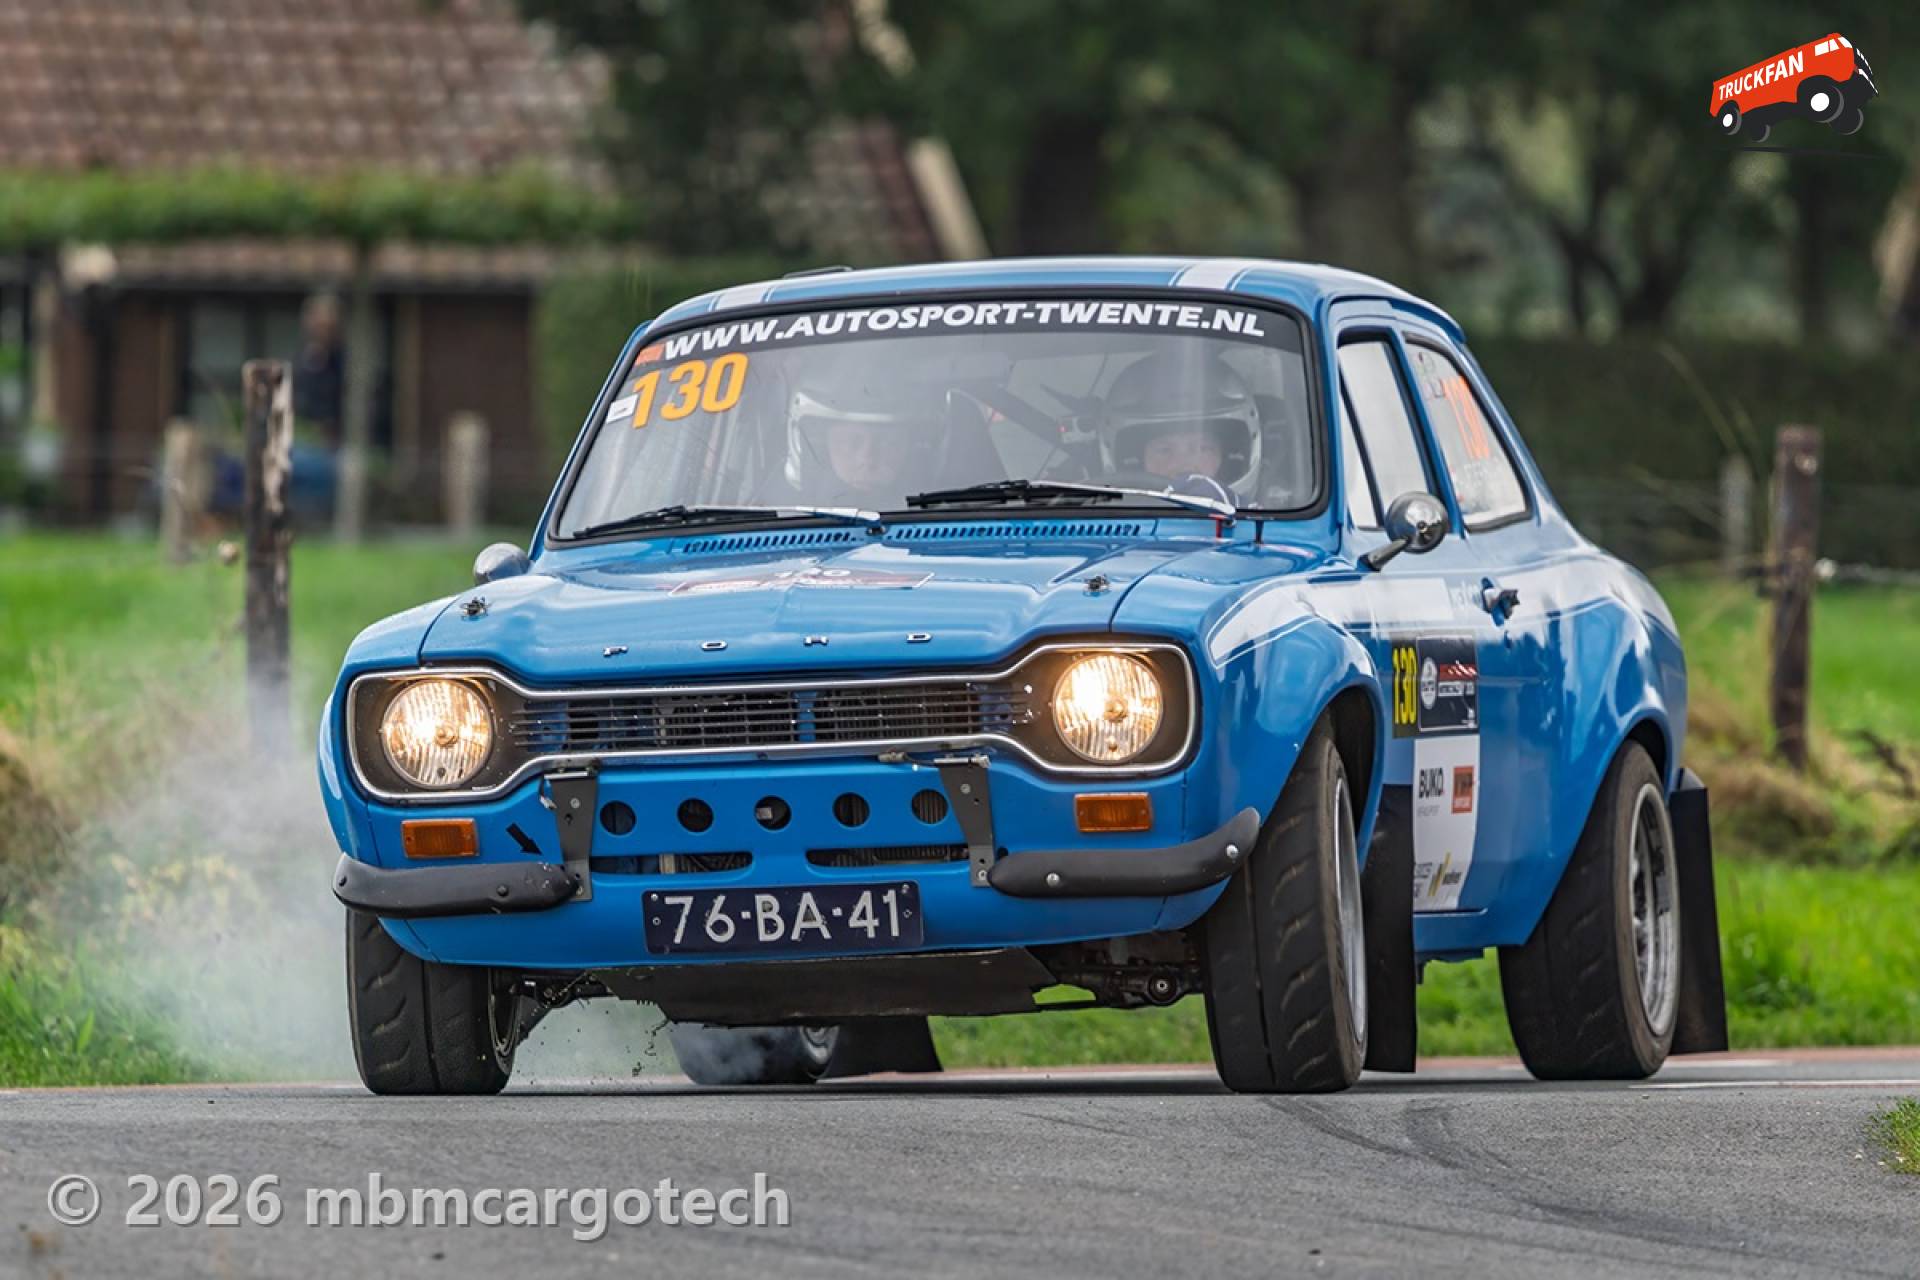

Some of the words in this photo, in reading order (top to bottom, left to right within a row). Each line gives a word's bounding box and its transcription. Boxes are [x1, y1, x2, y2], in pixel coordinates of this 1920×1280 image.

[665, 301, 1265, 360] WWW.AUTOSPORT-TWENTE.NL
[632, 352, 748, 429] 130
[603, 628, 933, 657] FORD
[1392, 646, 1417, 725] 130
[664, 889, 900, 945] 76-BA-41
